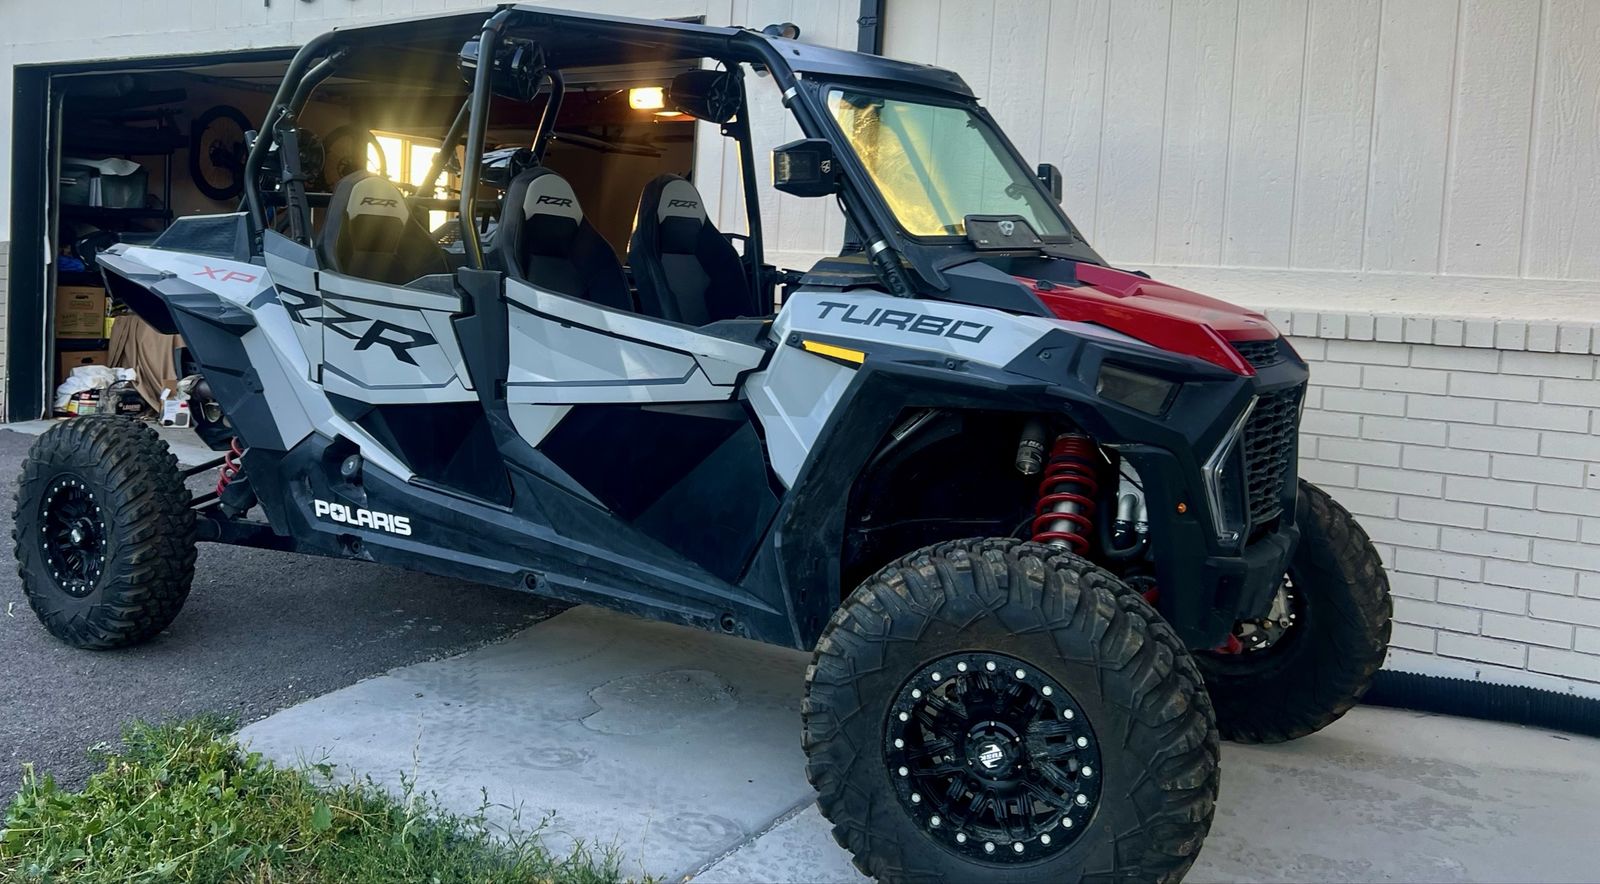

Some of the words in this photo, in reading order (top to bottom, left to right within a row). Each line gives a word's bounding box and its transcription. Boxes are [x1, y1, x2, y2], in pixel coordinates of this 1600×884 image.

[360, 196, 398, 208] RZR
[536, 195, 573, 207] RZR
[667, 199, 698, 209] RZR
[192, 265, 257, 283] XP
[275, 283, 439, 367] RZR
[817, 301, 994, 344] TURBO
[314, 499, 412, 536] POLARIS
